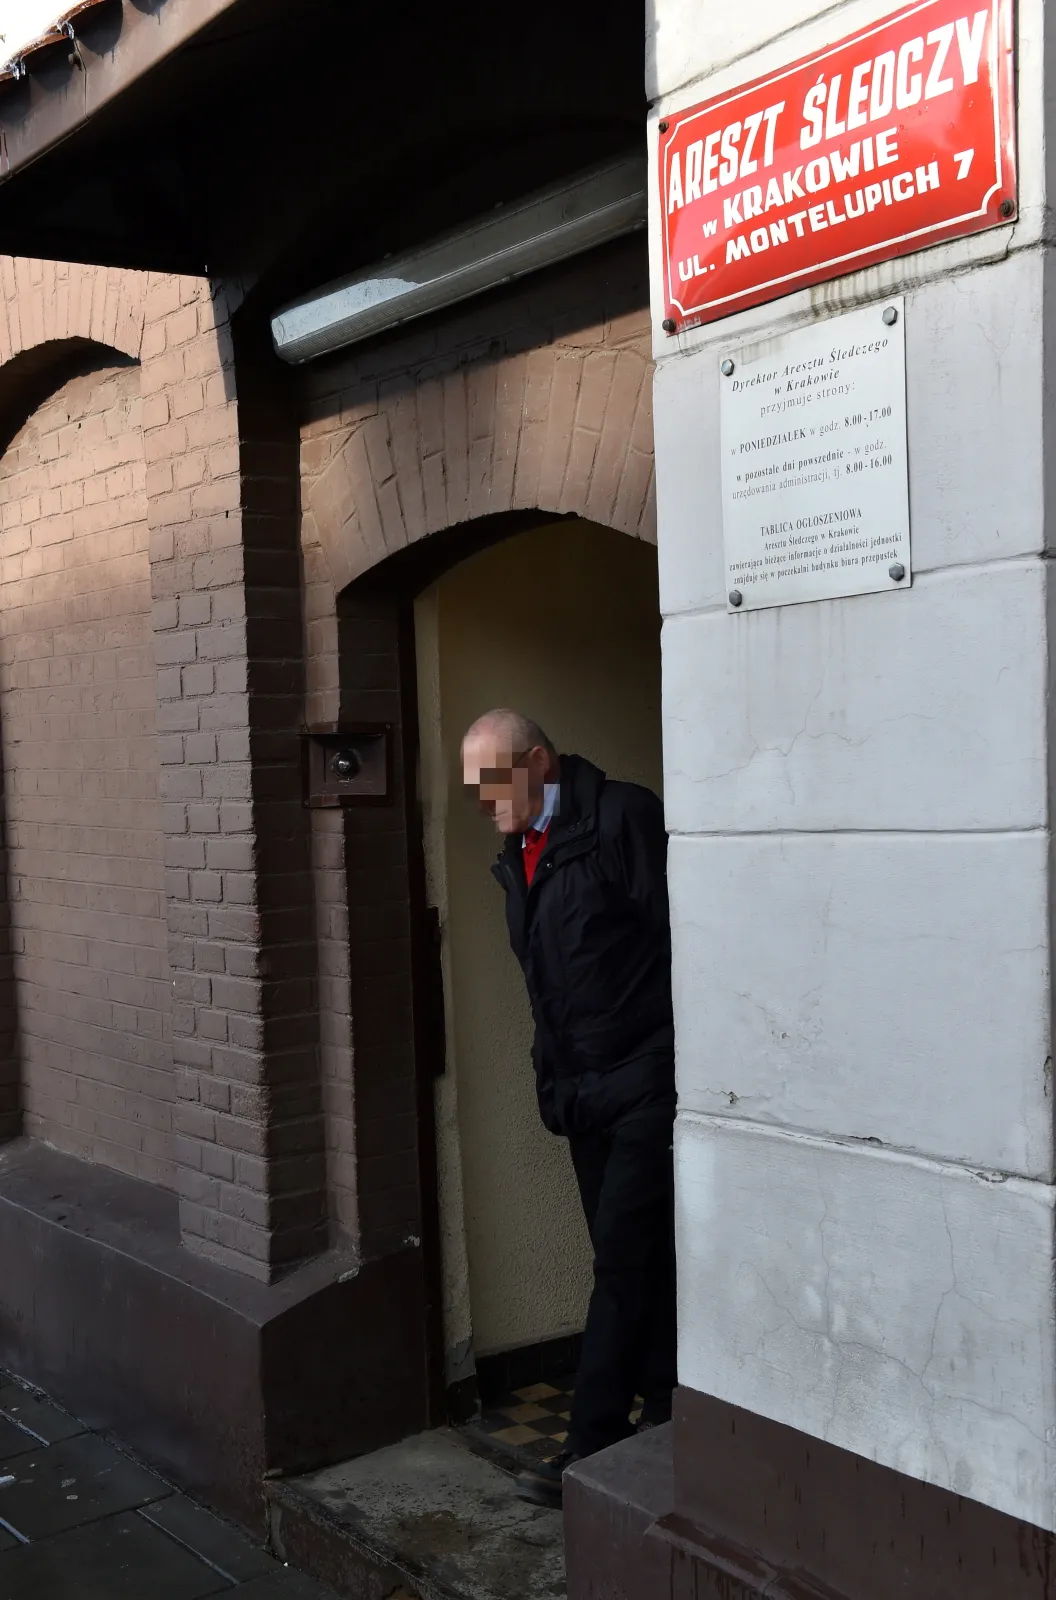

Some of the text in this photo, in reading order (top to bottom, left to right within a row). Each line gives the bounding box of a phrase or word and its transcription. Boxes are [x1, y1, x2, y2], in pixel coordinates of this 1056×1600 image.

[668, 9, 988, 214] ARESZT ŚLEDCZY
[702, 127, 899, 239] w KRAKOWIE
[678, 149, 975, 282] UL. MONTELUPICH 7
[732, 338, 888, 392] Dyrektor Aresztu Śledczego
[774, 368, 840, 395] w Krakowie
[760, 382, 855, 418] przyjmuje strony:
[731, 448, 737, 456] w
[809, 428, 816, 436] w
[819, 420, 841, 437] godz.
[736, 474, 742, 482] w
[782, 460, 795, 472] dni
[798, 449, 844, 471] powszednie
[854, 446, 861, 455] w
[864, 439, 887, 456] godz.
[760, 521, 794, 537] TABLICA
[764, 540, 787, 551] Aresztu
[788, 534, 819, 547] Śledczego
[828, 524, 860, 539] Krakowie
[788, 547, 821, 561] informacje
[870, 532, 902, 549] jednostki
[811, 560, 839, 572] budynku
[841, 557, 859, 567] biura
[861, 549, 899, 566] przepustek
